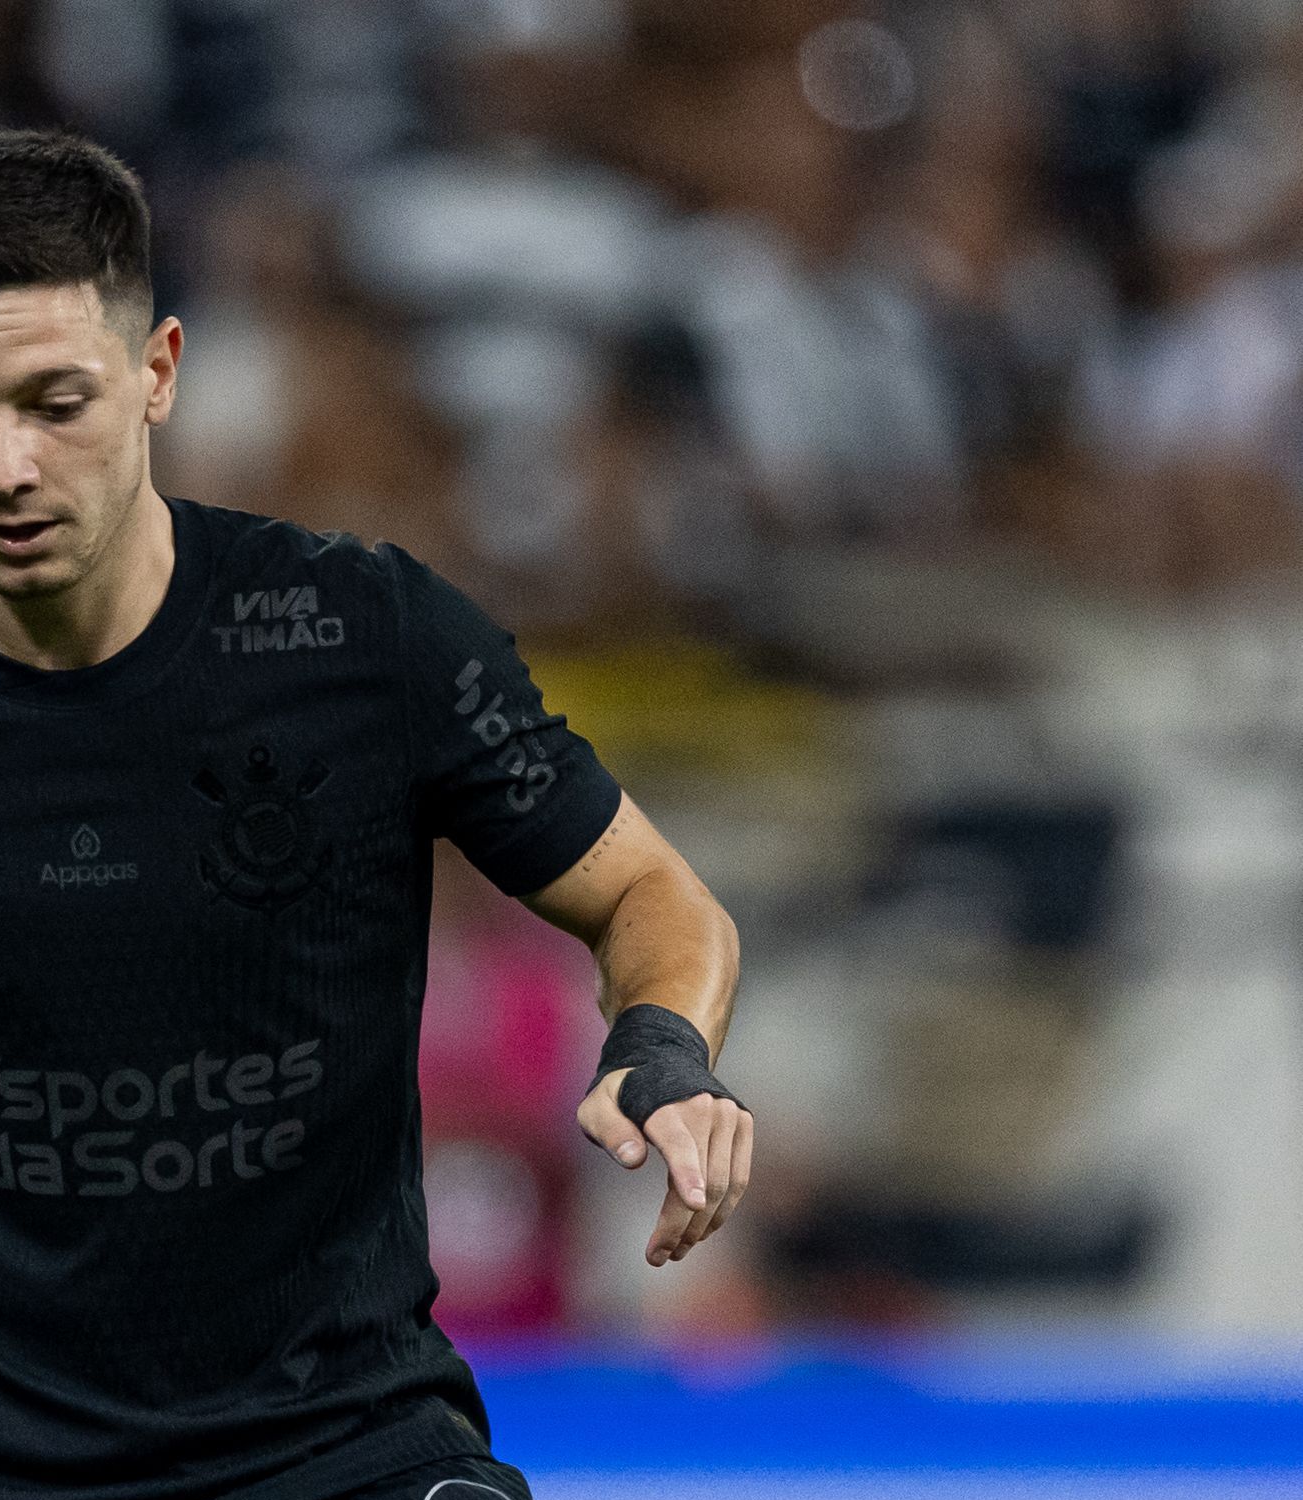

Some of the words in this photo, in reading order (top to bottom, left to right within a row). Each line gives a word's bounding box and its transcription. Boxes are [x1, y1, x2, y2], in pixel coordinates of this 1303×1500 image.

[232, 585, 319, 622] VIVA
[210, 614, 345, 653] TIMÃO
[40, 863, 139, 890] Appgas
